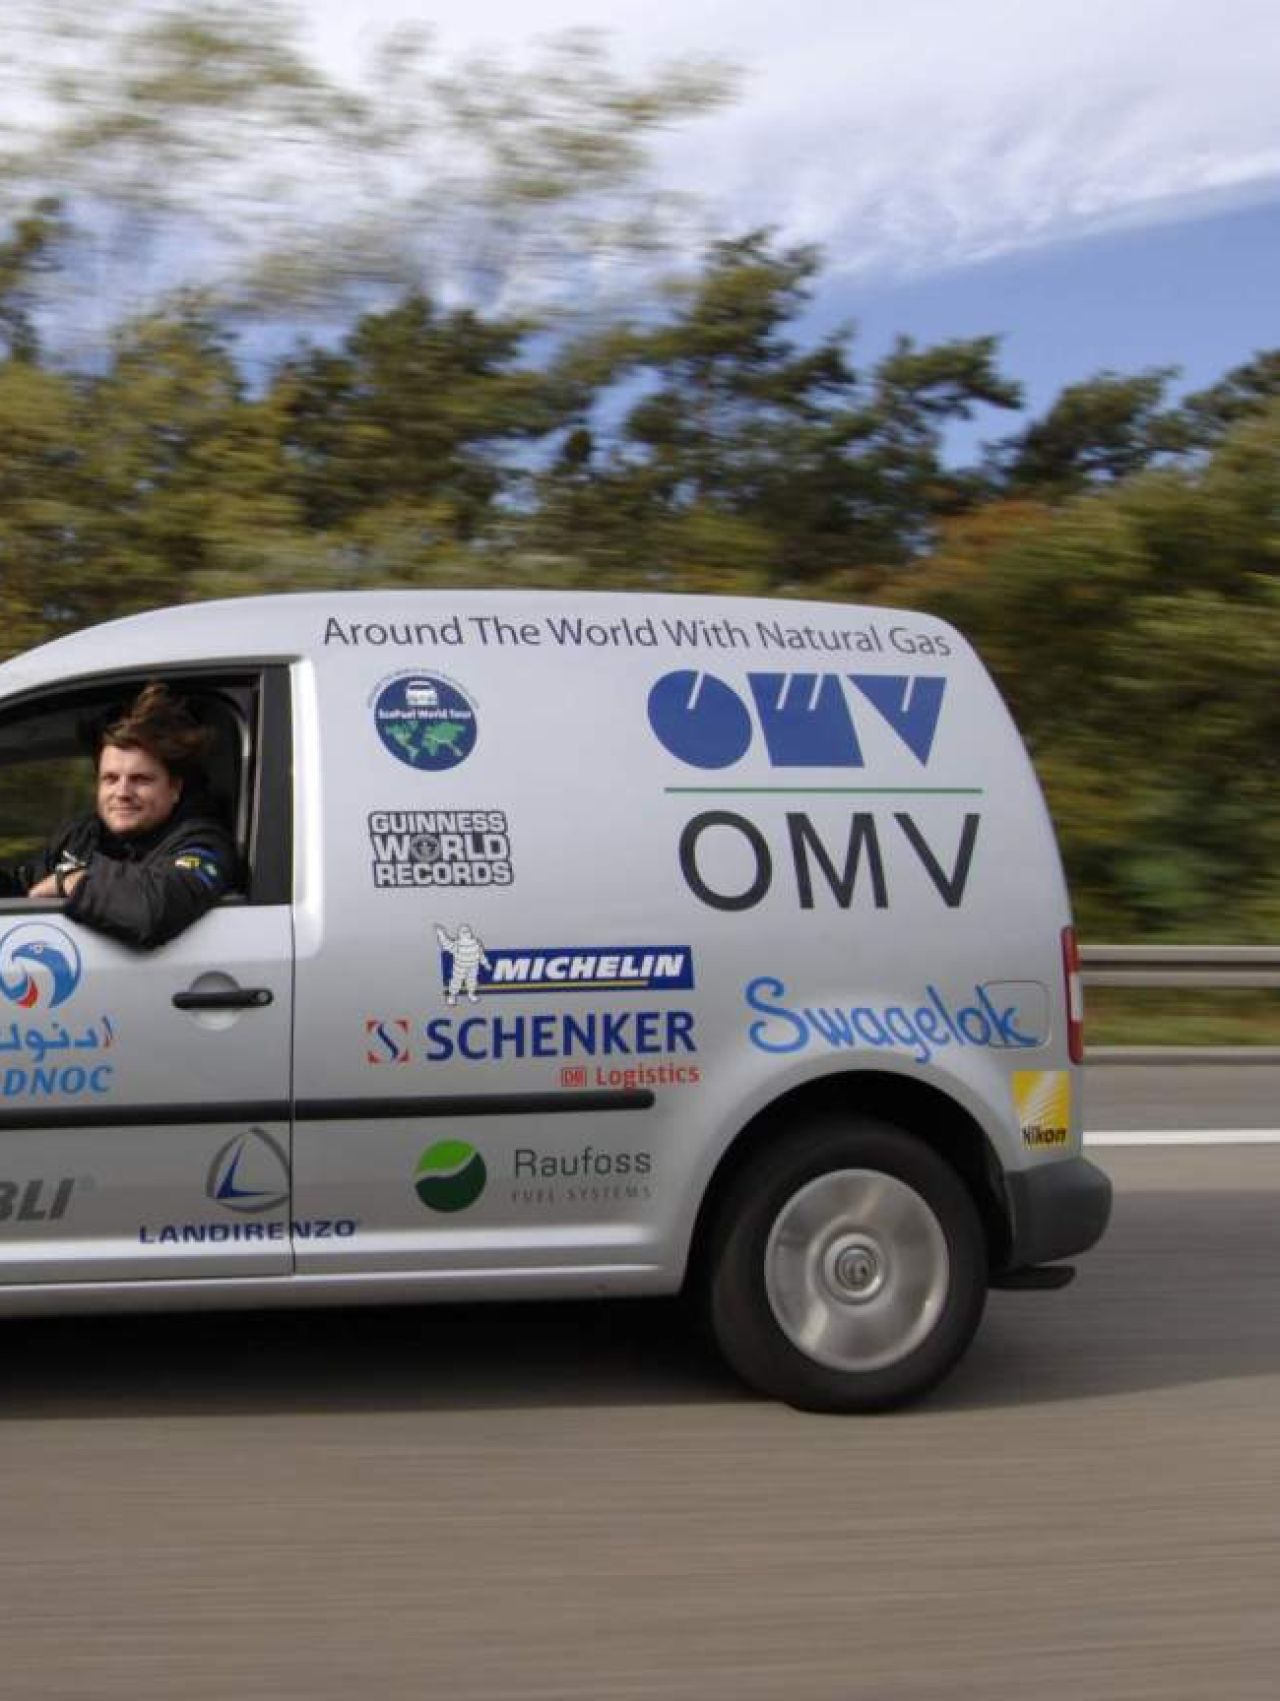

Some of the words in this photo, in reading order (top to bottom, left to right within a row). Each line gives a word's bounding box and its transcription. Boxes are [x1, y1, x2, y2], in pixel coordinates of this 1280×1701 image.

[323, 616, 464, 646] Around
[468, 616, 541, 646] The
[546, 618, 658, 647] World
[662, 619, 750, 648] With
[755, 621, 884, 653] Natural
[888, 626, 951, 656] Gas
[370, 811, 507, 833] GUINNESS
[374, 861, 514, 887] RECORDS
[679, 810, 981, 912] OMV
[493, 955, 684, 981] MICHELIN
[745, 976, 1041, 1064] Swagelok
[426, 1012, 696, 1062] SCHENKER
[596, 1064, 700, 1089] Logistics
[1022, 1125, 1066, 1144] Nikon
[515, 1148, 652, 1178] Raufoss
